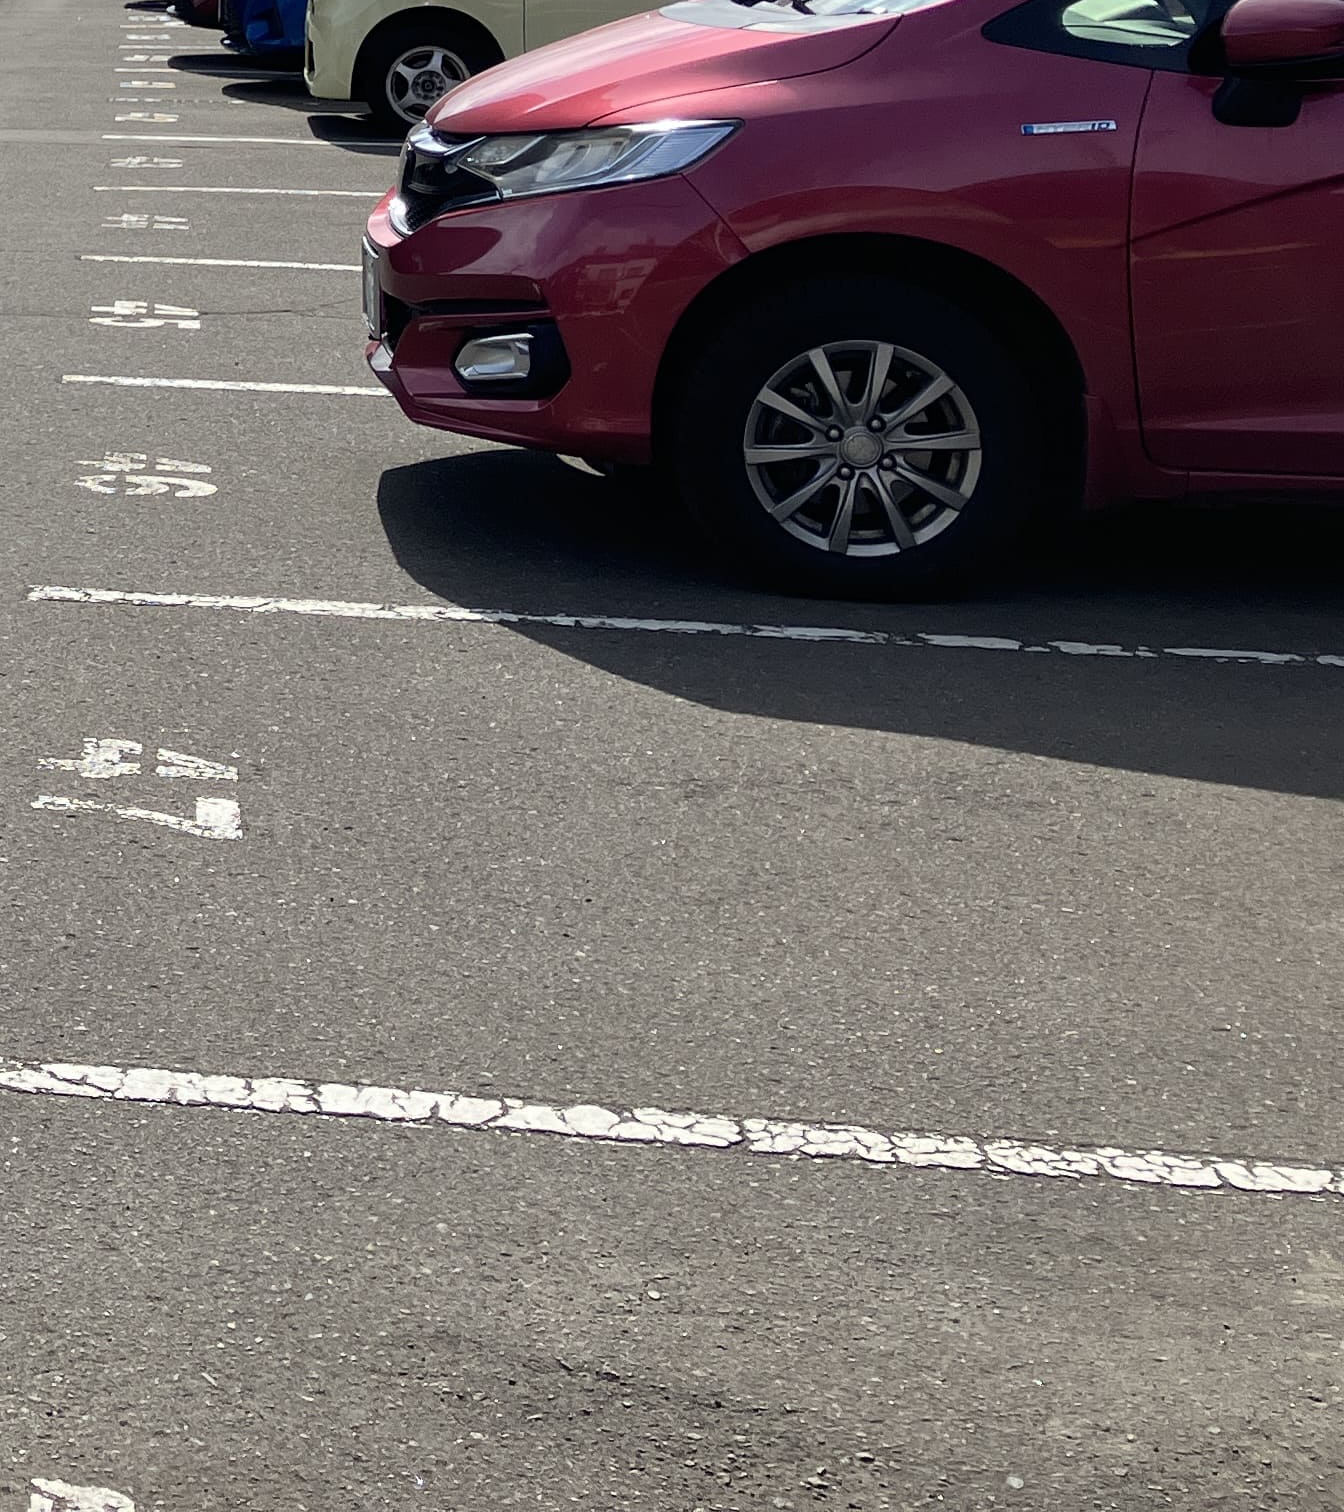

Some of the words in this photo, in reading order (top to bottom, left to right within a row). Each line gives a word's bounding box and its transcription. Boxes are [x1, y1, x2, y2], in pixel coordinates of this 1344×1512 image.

[88, 300, 201, 329] 45
[73, 451, 218, 498] 46
[30, 737, 244, 841] 47
